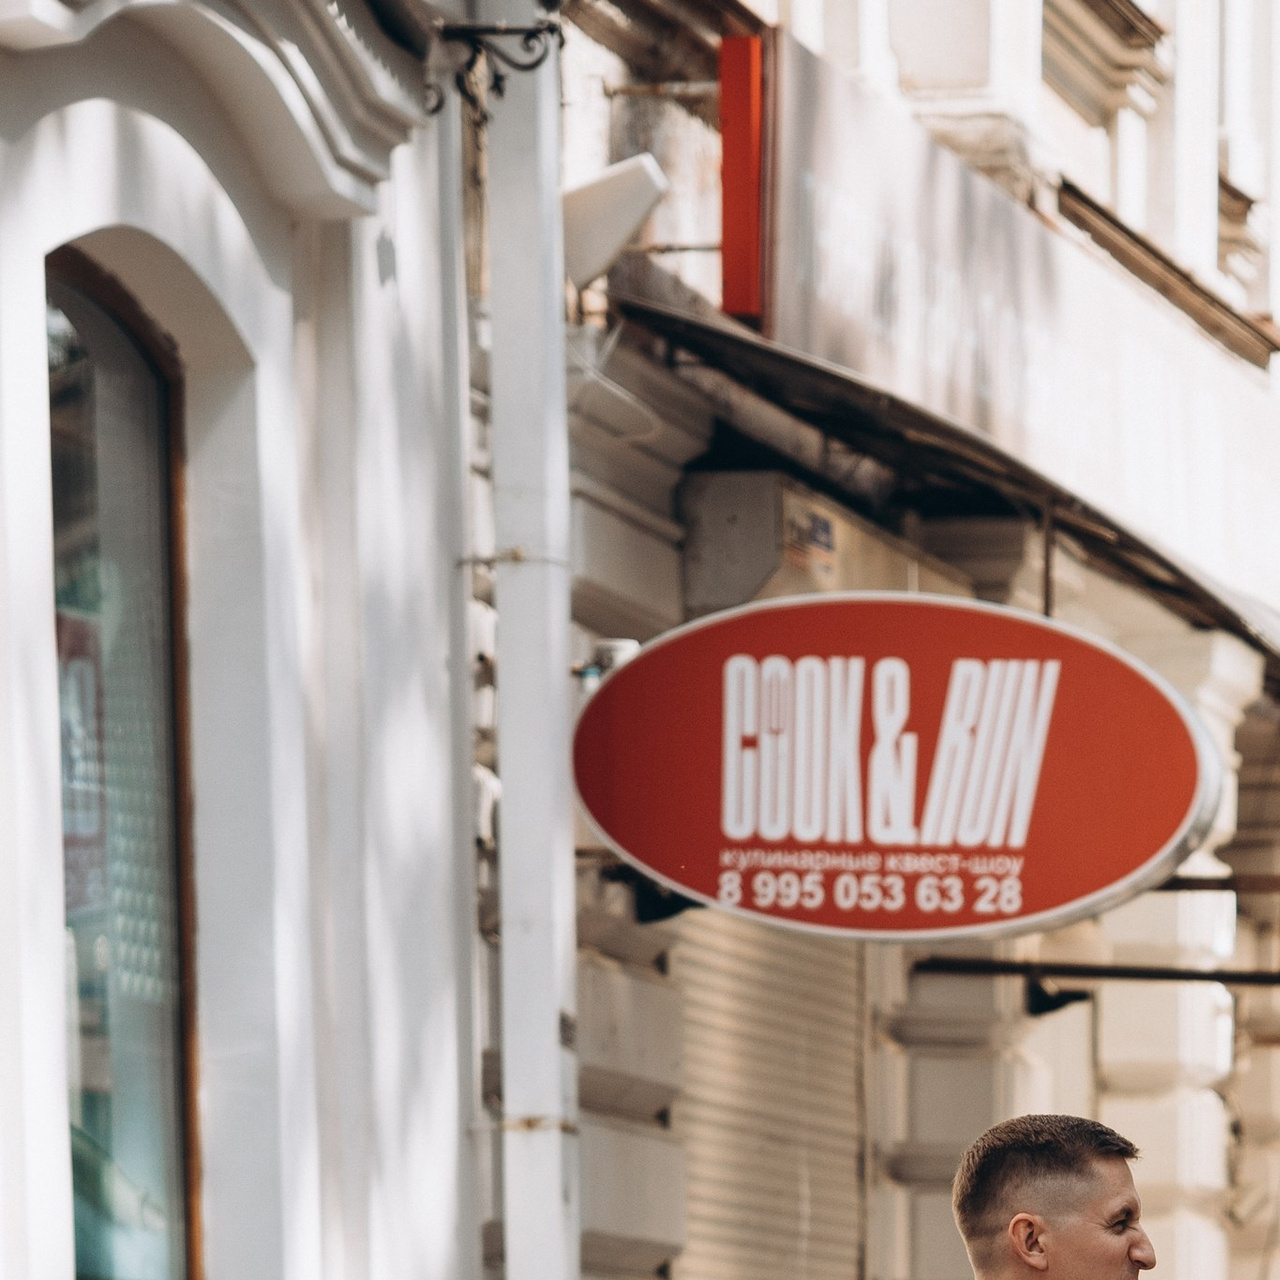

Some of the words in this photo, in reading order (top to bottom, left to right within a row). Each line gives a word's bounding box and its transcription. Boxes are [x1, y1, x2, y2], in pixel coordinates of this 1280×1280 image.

[722, 654, 865, 845] COOK
[919, 657, 1062, 849] RUN
[717, 870, 743, 905] 8
[752, 870, 825, 909] 995
[833, 872, 906, 911] 053
[914, 874, 964, 913] 63
[971, 876, 1023, 914] 28
